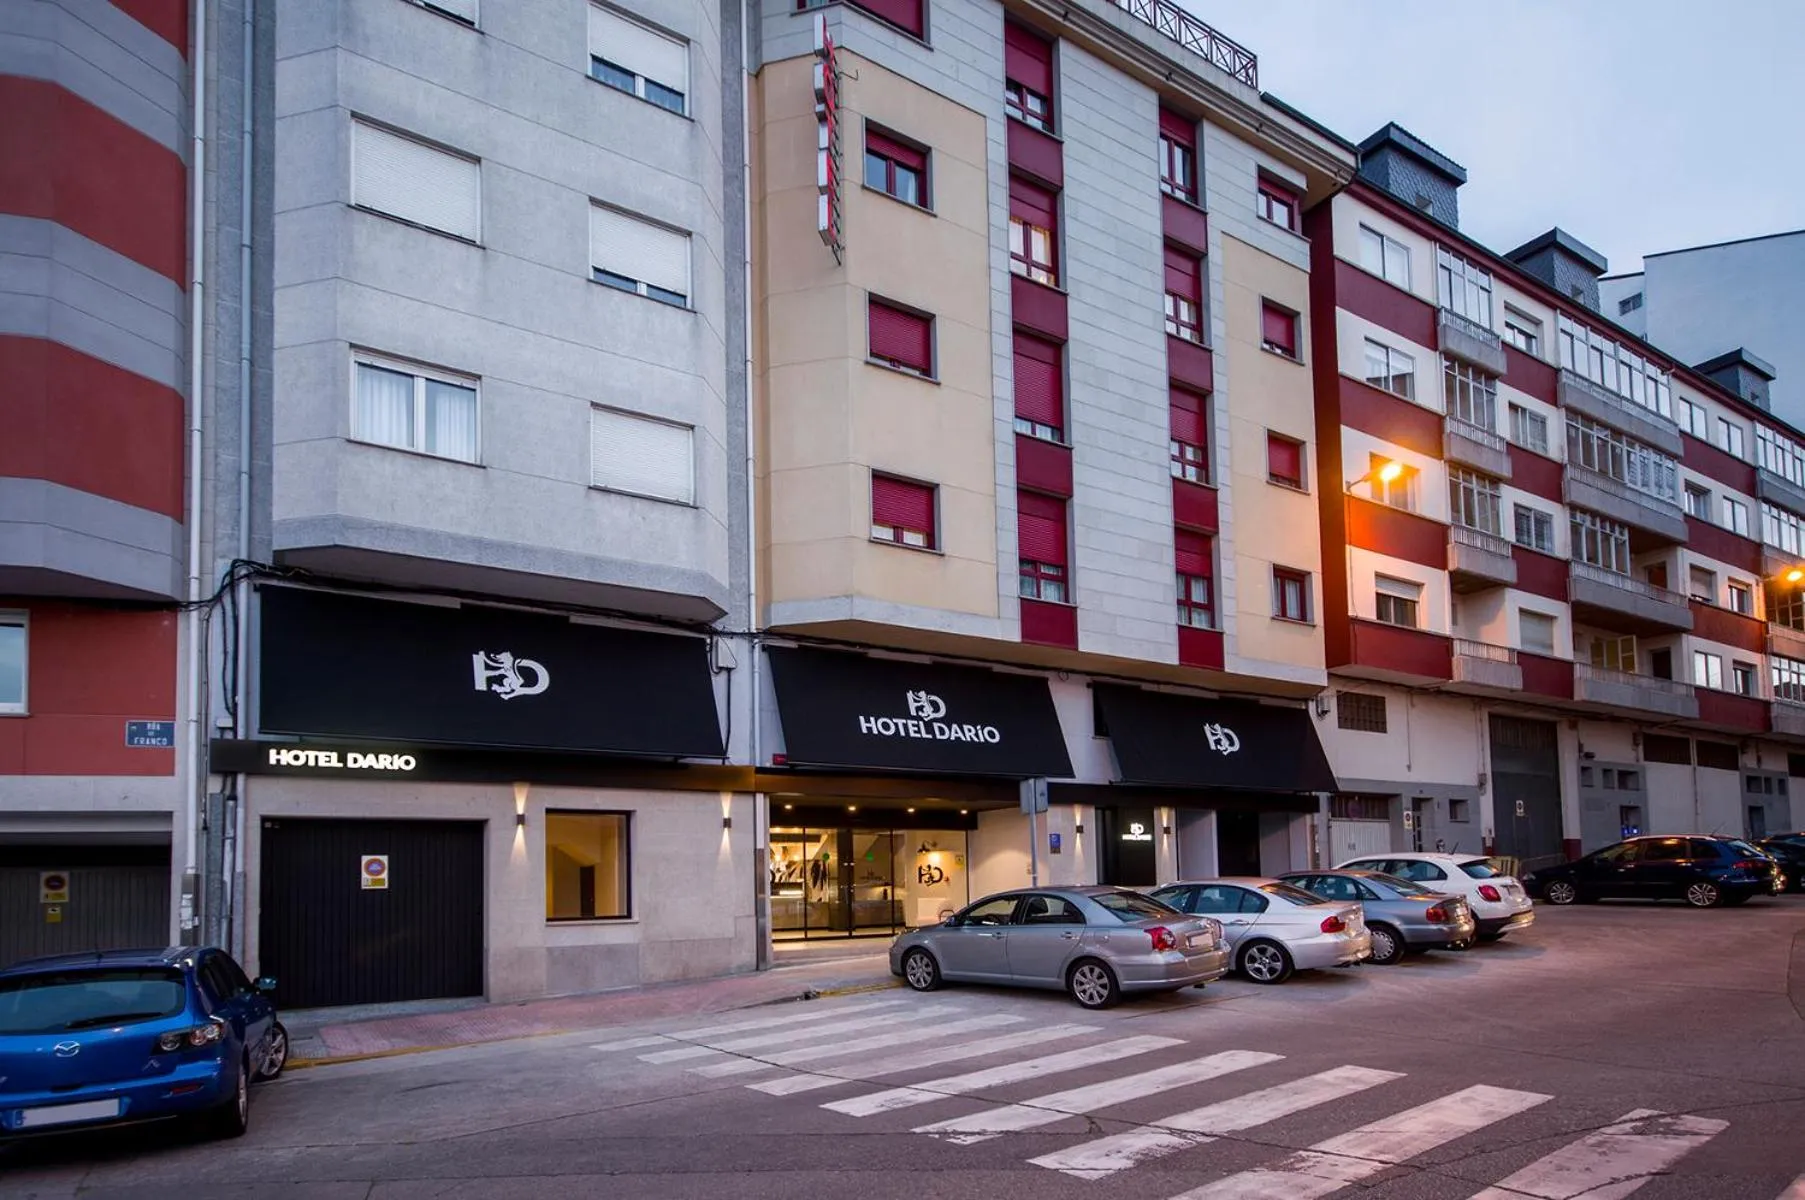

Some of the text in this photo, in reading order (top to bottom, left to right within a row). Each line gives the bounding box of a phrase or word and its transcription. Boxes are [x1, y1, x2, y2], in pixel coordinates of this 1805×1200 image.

[859, 715, 932, 739] HOTEL
[134, 737, 167, 746] FRANCO
[269, 748, 343, 768] HOTEL
